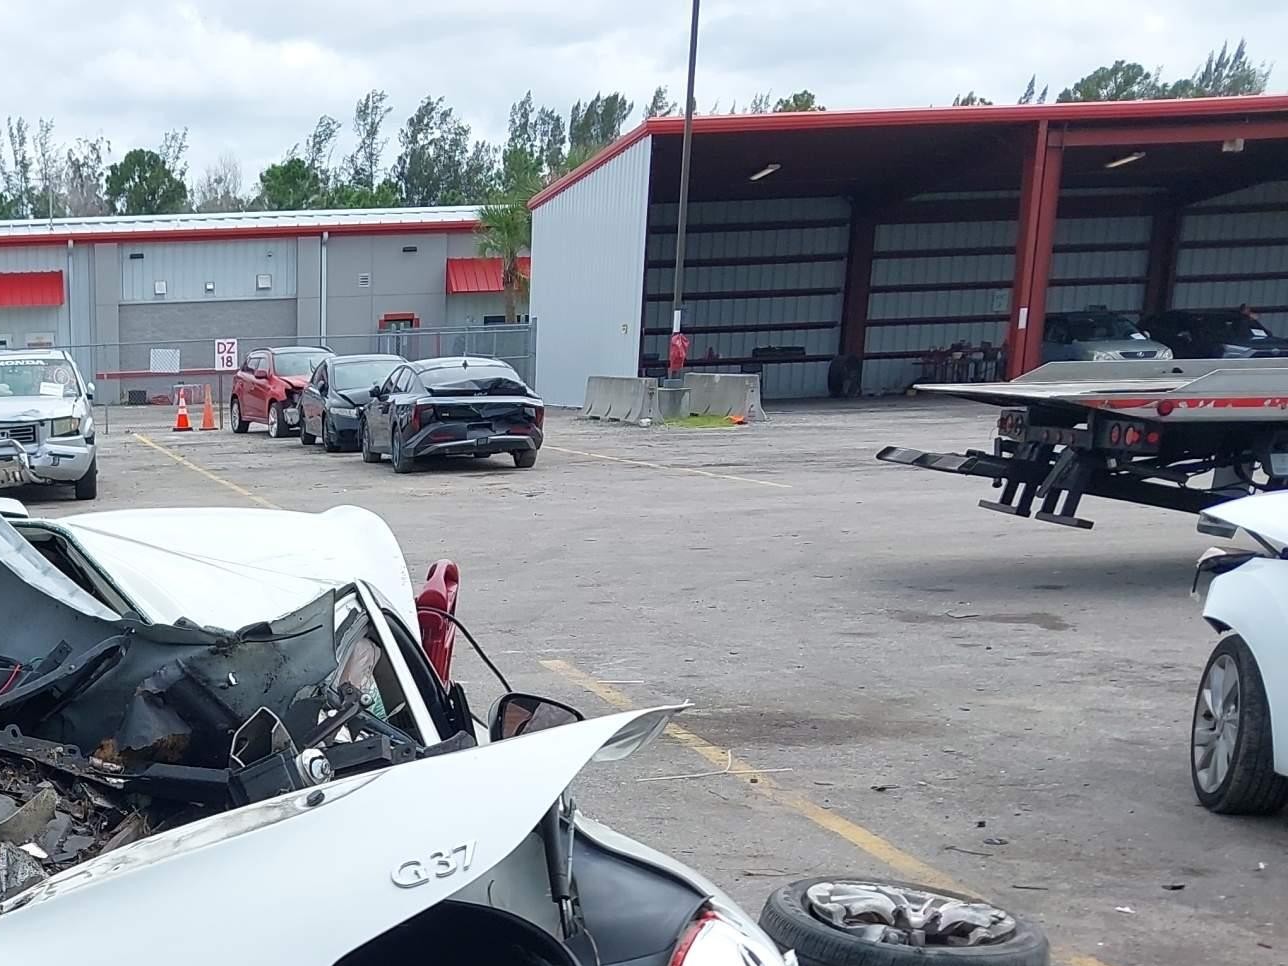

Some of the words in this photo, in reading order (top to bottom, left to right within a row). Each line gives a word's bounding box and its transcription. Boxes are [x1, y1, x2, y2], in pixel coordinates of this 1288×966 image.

[217, 341, 235, 354] DZ
[221, 355, 233, 367] 18
[391, 839, 480, 889] G37
